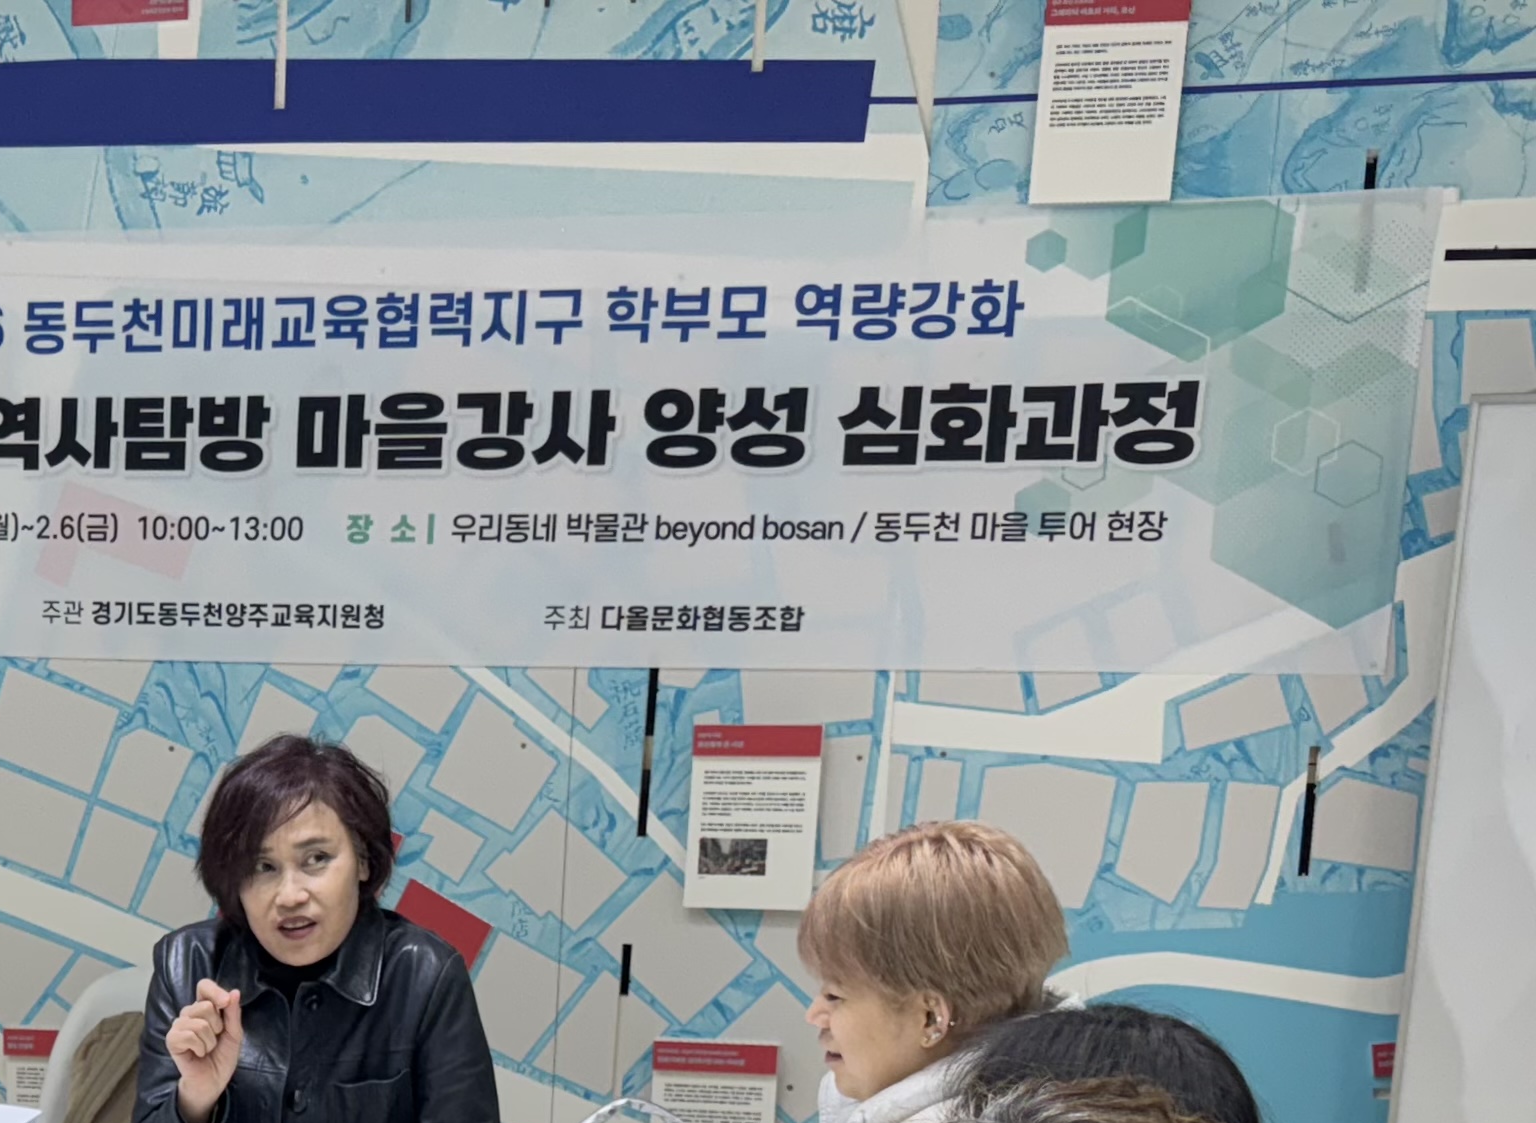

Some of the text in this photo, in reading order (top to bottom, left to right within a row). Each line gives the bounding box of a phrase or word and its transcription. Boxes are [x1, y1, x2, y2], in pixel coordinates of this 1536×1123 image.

[24, 289, 583, 354] 동두천미래교육협력지구
[607, 285, 767, 343] 학부모
[795, 279, 1025, 342] 역량강화
[296, 390, 617, 471] 마을강사
[644, 386, 809, 469] 양성
[838, 381, 1200, 466] 심화과정
[138, 514, 304, 542] 10:00~13:00
[452, 513, 557, 544] 우리동네
[566, 512, 648, 543] 박물관
[655, 514, 755, 547] beyond
[762, 514, 844, 541] bosan
[875, 511, 961, 543] 동두천
[971, 510, 1030, 542] 마을
[1037, 511, 1097, 542] 투어
[1108, 510, 1169, 542] 현장
[42, 600, 385, 629] 주관 경기도동두천양주교육지원청
[543, 604, 805, 633] 주최 다올문화협동조합
